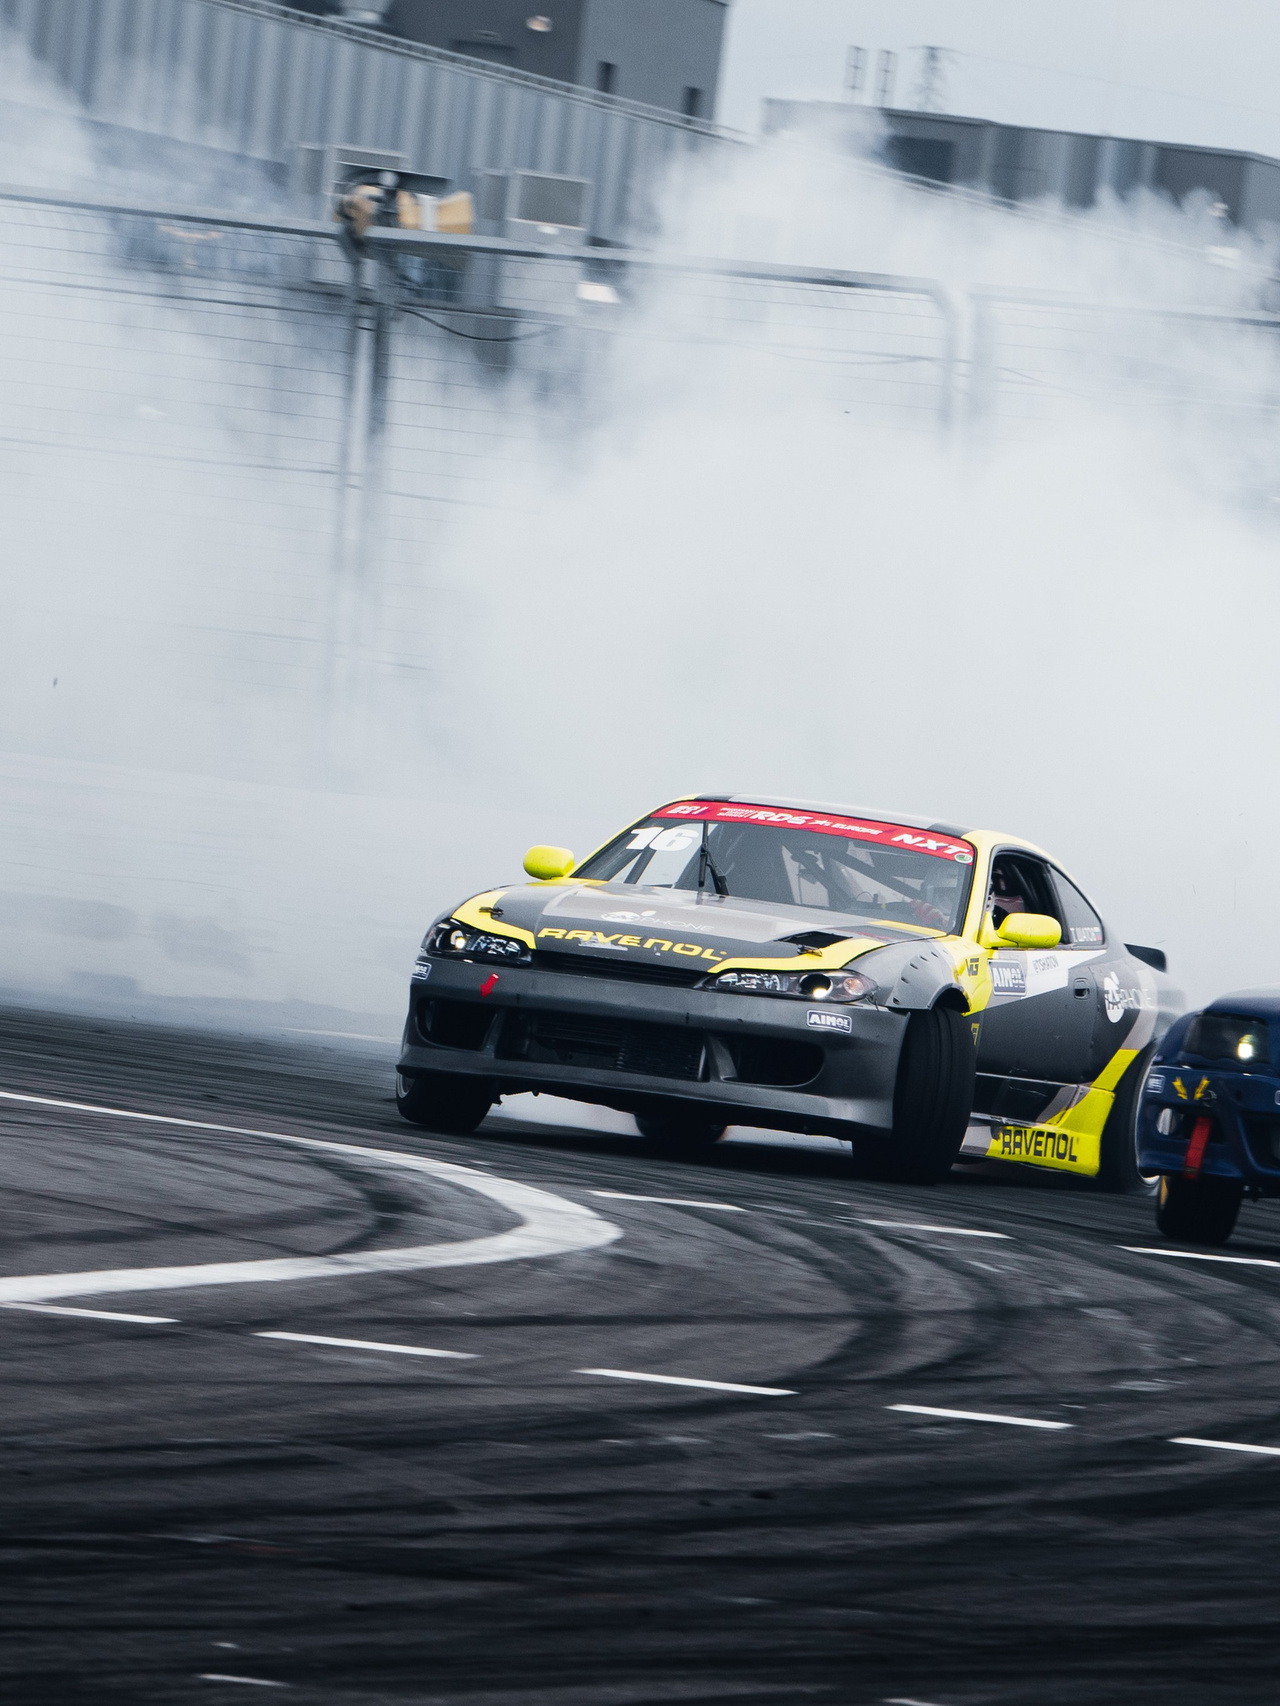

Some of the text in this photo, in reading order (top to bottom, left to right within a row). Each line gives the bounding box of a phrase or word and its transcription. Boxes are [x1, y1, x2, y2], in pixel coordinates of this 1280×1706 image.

[625, 826, 700, 851] 16
[750, 811, 812, 825] RDS
[891, 834, 970, 854] NXT
[538, 928, 724, 962] RAVENOL
[993, 967, 1026, 989] AIMOL
[809, 1013, 850, 1030] AIMOL
[1001, 1128, 1078, 1162] RAVENOL
